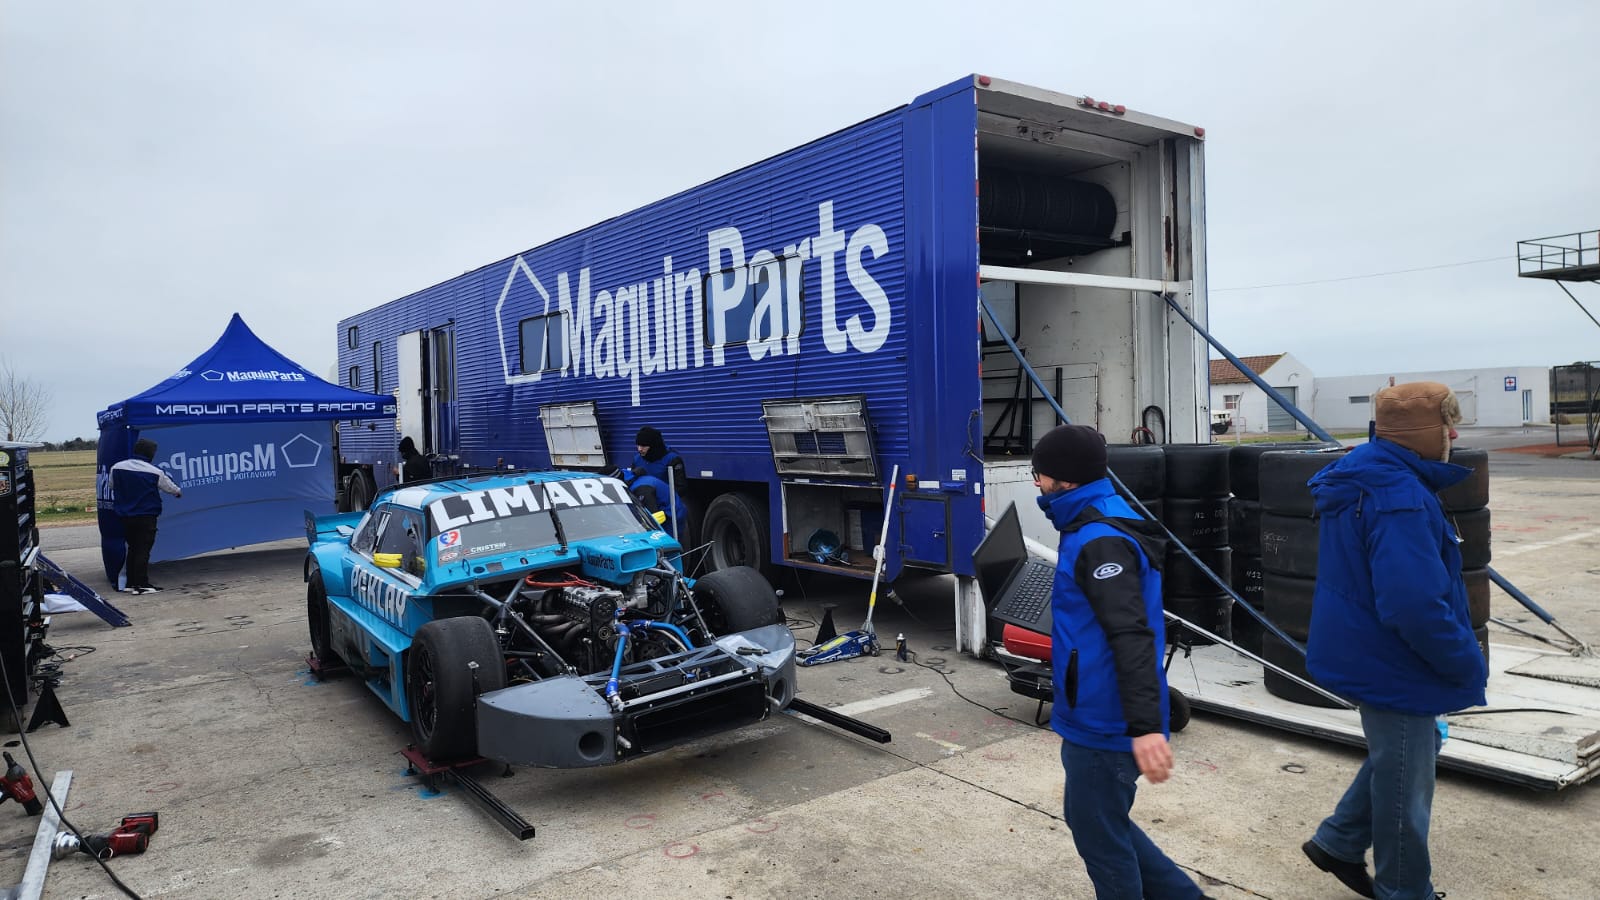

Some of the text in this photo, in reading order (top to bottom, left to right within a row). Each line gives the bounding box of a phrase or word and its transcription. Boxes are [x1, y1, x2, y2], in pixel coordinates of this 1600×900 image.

[557, 200, 891, 406] MaquinParts
[226, 370, 305, 382] MaquinParts
[156, 403, 238, 416] MAQUIN
[242, 403, 315, 414] PARTS
[317, 402, 376, 412] RACING
[429, 477, 633, 533] LIMART
